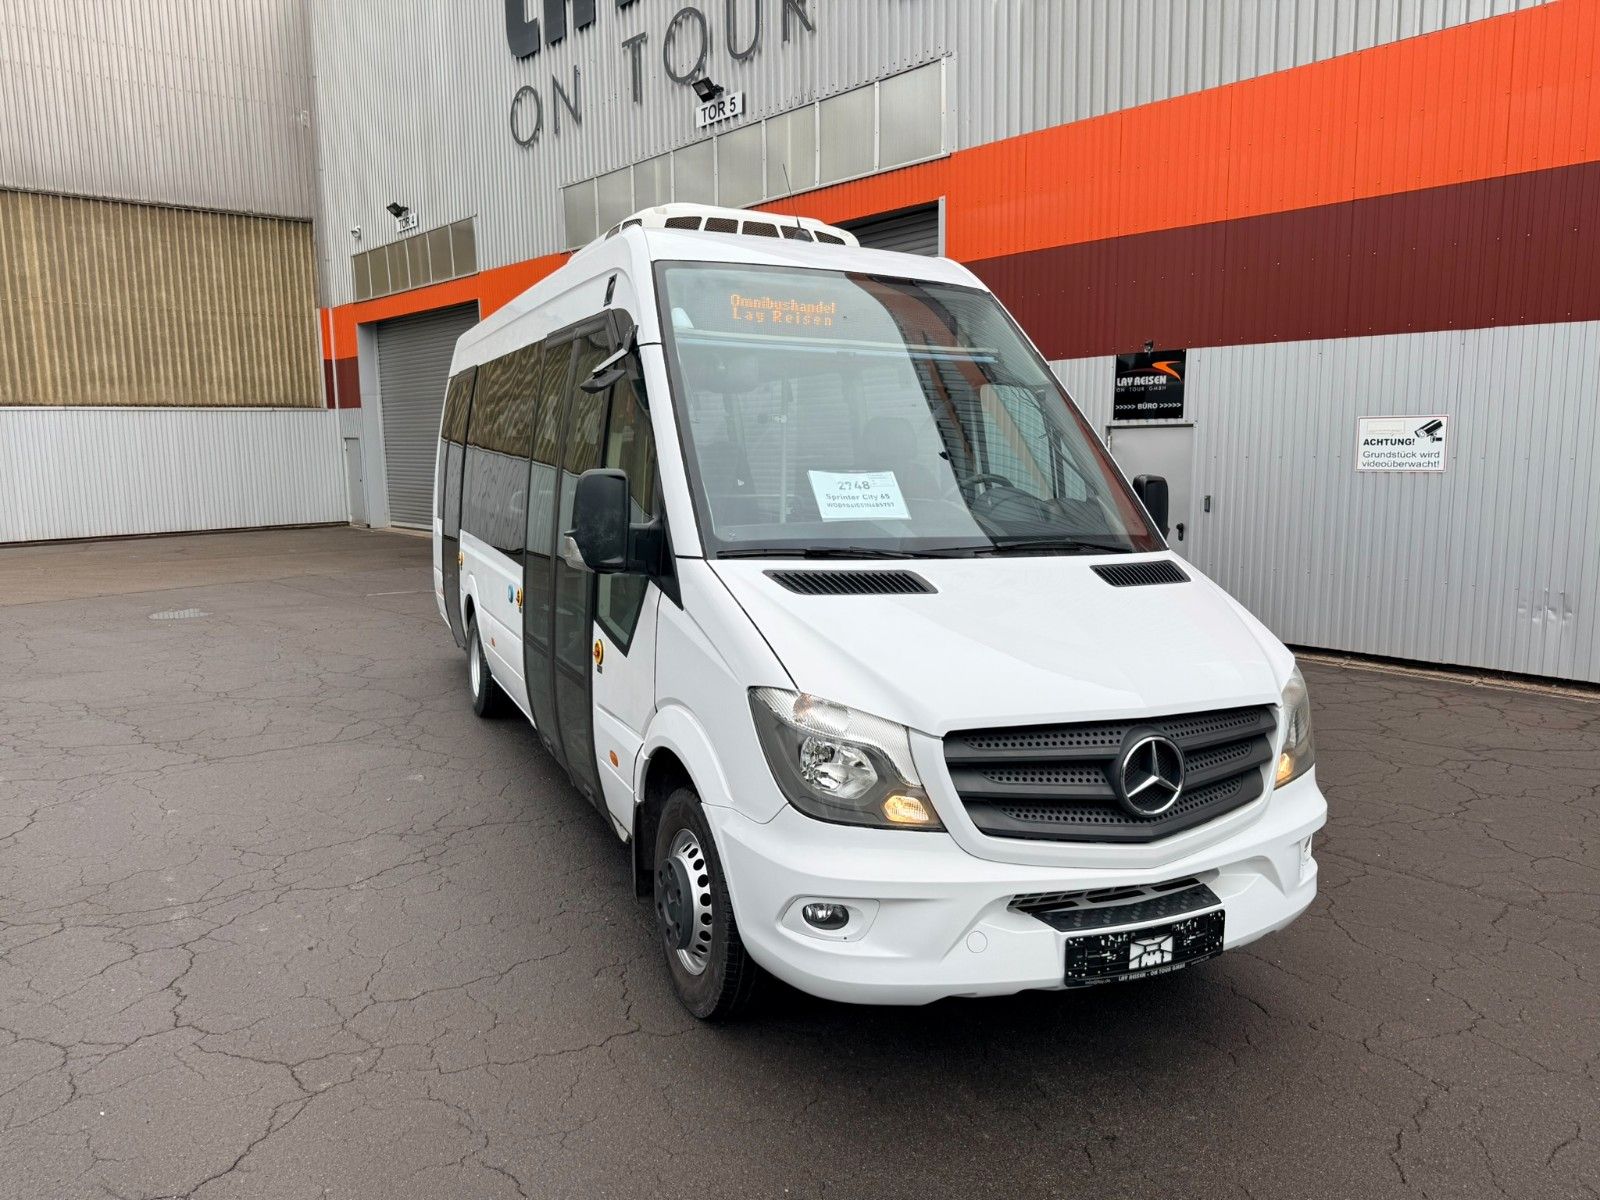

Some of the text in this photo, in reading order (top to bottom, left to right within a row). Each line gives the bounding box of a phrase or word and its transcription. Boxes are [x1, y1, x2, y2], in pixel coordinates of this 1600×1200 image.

[509, 64, 582, 147] ON
[700, 96, 736, 123] TOR 5
[730, 294, 837, 314] Omnibushandel
[772, 310, 833, 327] Reisen
[1116, 375, 1167, 387] LAY REISEN
[1137, 401, 1158, 410] BÜRO
[1363, 438, 1415, 446] ACHTUNG!
[1362, 450, 1440, 458] Grundstück wird
[1361, 460, 1440, 468] videoüberwacht!
[837, 481, 871, 491] 2748
[826, 493, 860, 502] Sprinter
[862, 494, 878, 502] City
